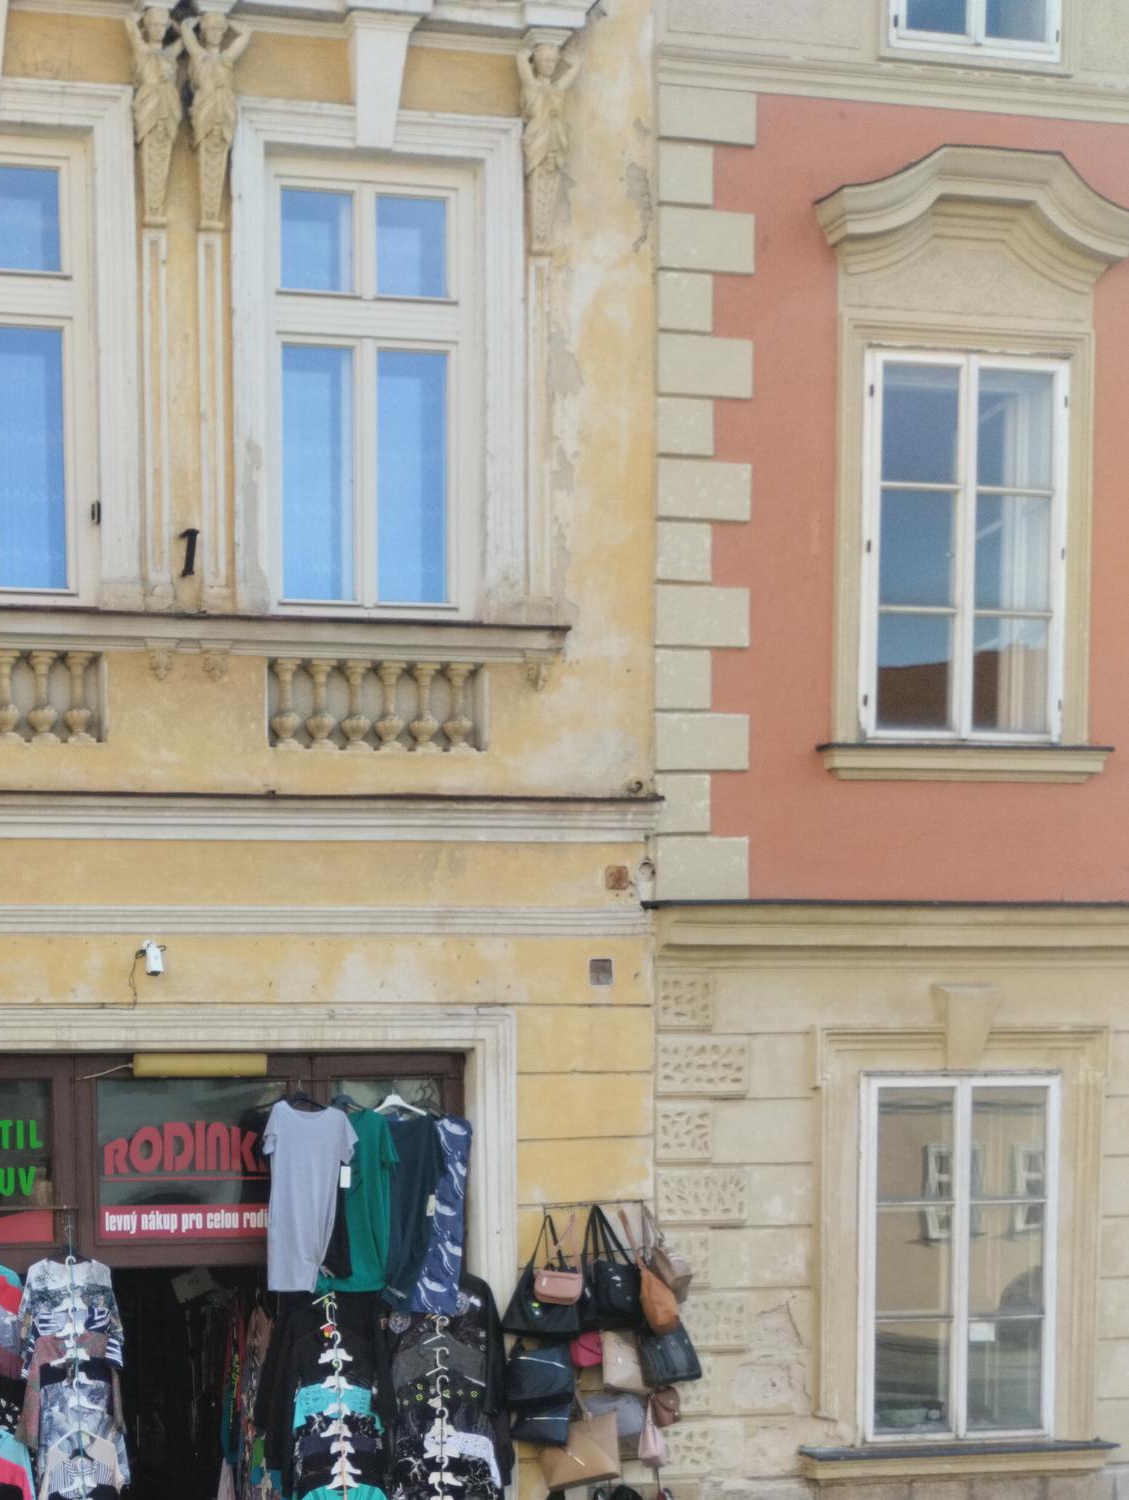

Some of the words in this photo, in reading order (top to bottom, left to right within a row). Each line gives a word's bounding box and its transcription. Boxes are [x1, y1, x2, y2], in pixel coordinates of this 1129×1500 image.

[103, 1120, 268, 1175] RODINK
[105, 1211, 137, 1234] levný
[141, 1210, 177, 1232] nákup
[182, 1211, 202, 1232] pro
[207, 1209, 239, 1229] celou
[243, 1208, 268, 1229] rodi
